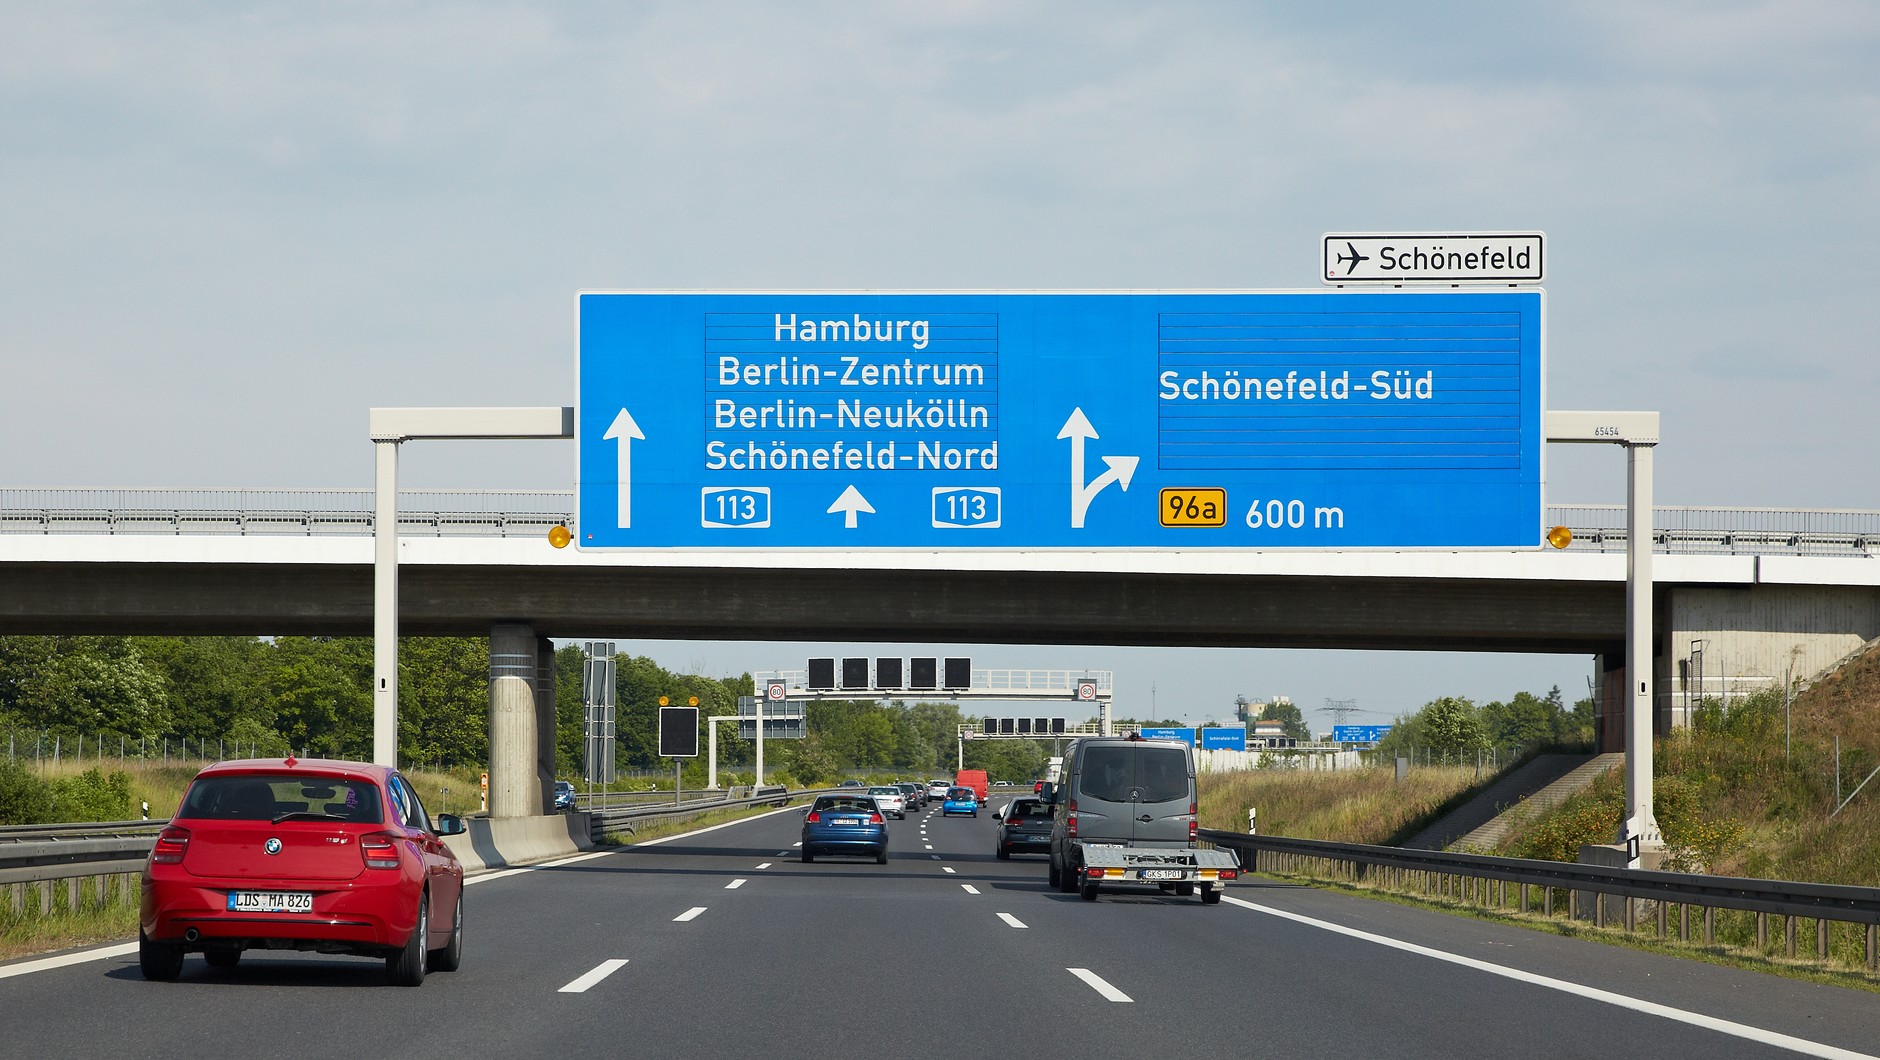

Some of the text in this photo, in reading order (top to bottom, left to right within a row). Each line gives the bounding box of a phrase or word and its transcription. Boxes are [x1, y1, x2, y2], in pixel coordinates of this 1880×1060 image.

[1379, 245, 1530, 270] Schönefeld
[775, 313, 929, 349] Hamburg
[719, 356, 984, 386] Berlin-Zentrum
[1159, 370, 1433, 400] Schönefeld-Süd
[715, 398, 988, 428] Berlin-Neukölln
[1594, 426, 1619, 436] 65454
[705, 440, 998, 470] Schönefeld-Nord
[716, 495, 756, 520] 113
[947, 495, 986, 520] 113
[1170, 495, 1217, 520] 96a
[1245, 499, 1344, 529] 600 m
[1147, 870, 1180, 878] GKS 1P01
[236, 893, 310, 908] LDS MA 826
